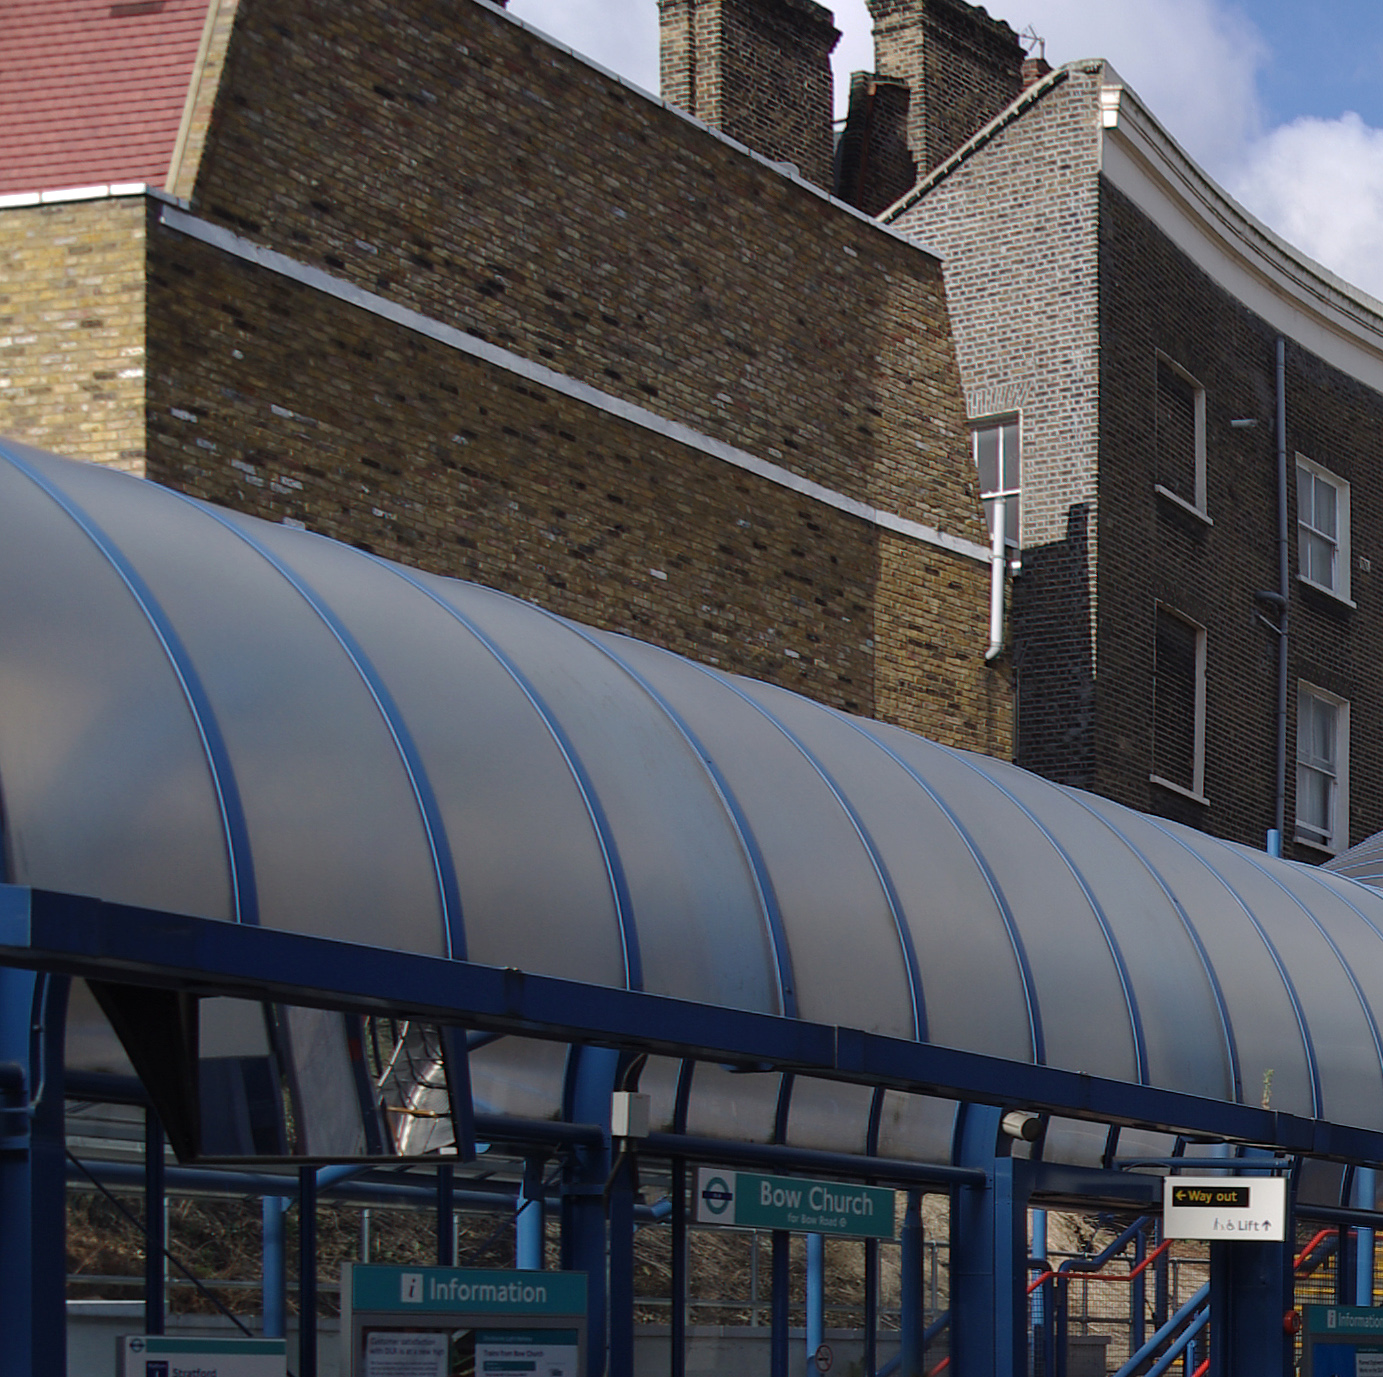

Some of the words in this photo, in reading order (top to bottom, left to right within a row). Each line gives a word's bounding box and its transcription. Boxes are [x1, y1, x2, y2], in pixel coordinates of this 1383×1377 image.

[760, 1180, 803, 1209] Bow
[808, 1186, 874, 1216] Church
[1187, 1190, 1213, 1204] Way
[1215, 1191, 1238, 1202] out
[787, 1213, 799, 1223] for
[801, 1214, 817, 1225] Bow
[818, 1216, 838, 1228] Road
[1238, 1220, 1260, 1231] Lift
[429, 1277, 548, 1303] Information
